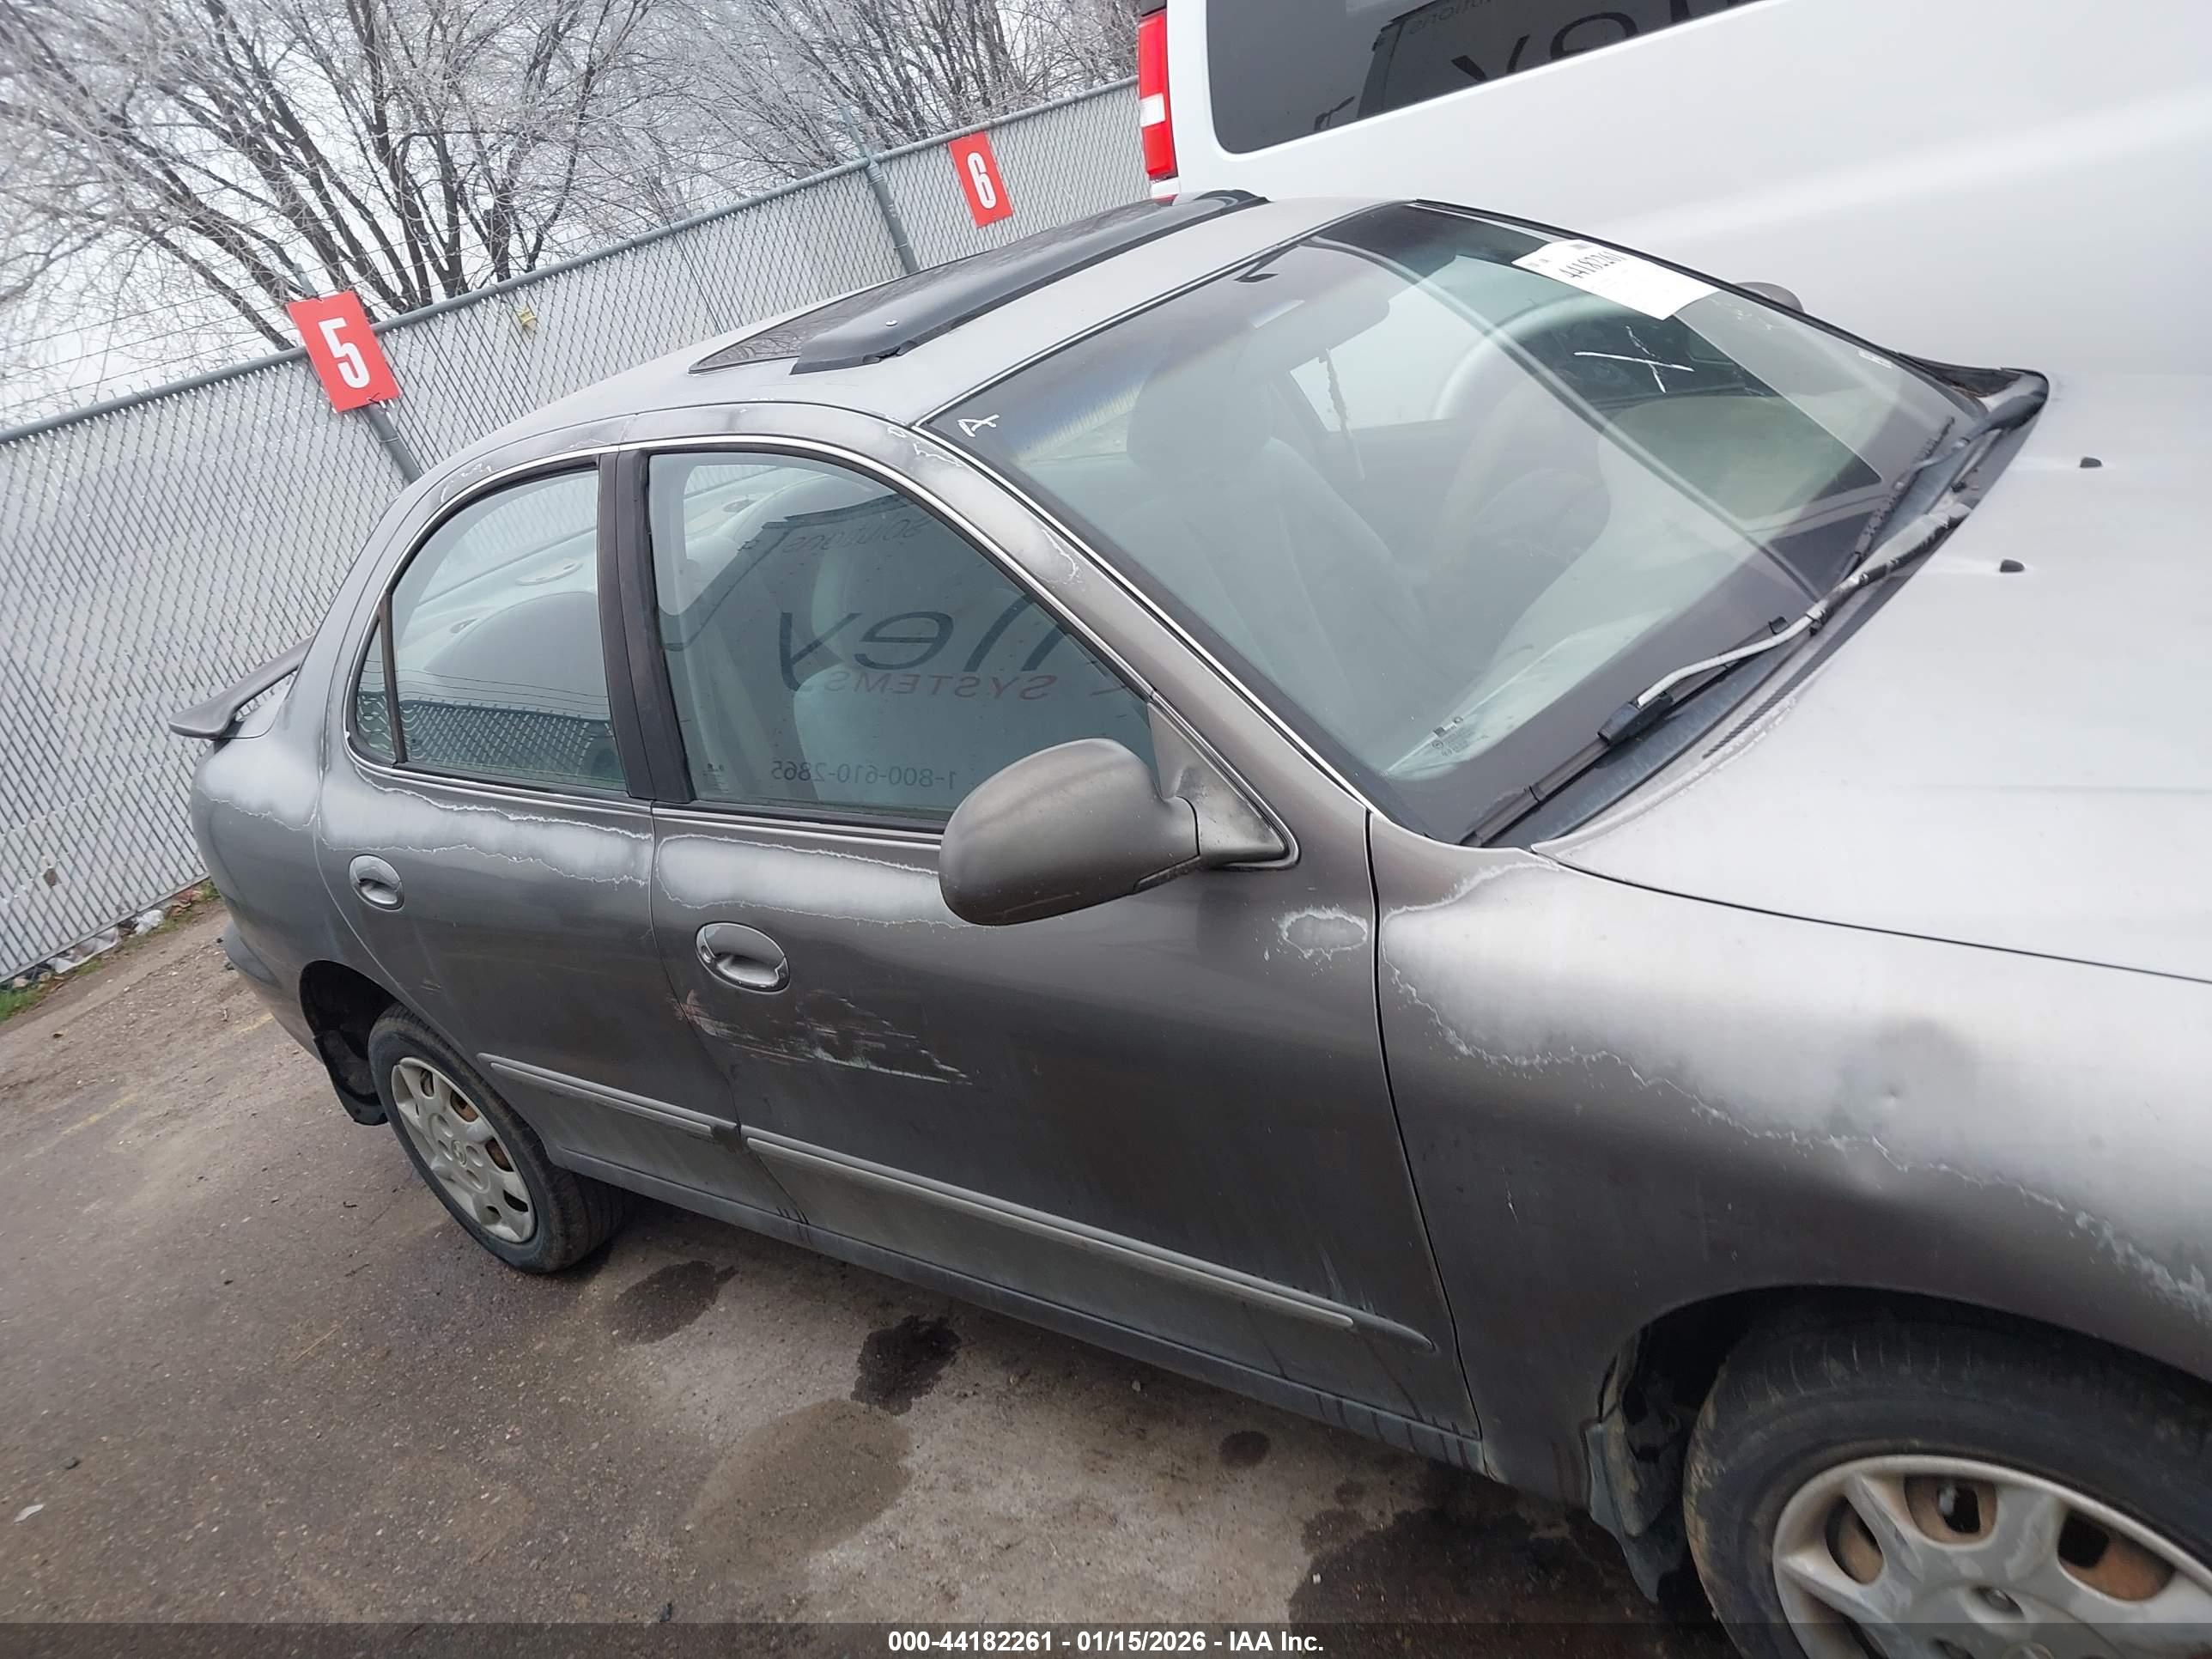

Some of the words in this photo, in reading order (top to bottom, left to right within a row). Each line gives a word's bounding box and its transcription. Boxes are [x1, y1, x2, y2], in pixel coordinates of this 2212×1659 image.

[967, 152, 997, 210] 6
[1559, 251, 1628, 279] 44182261
[318, 317, 371, 389] 5
